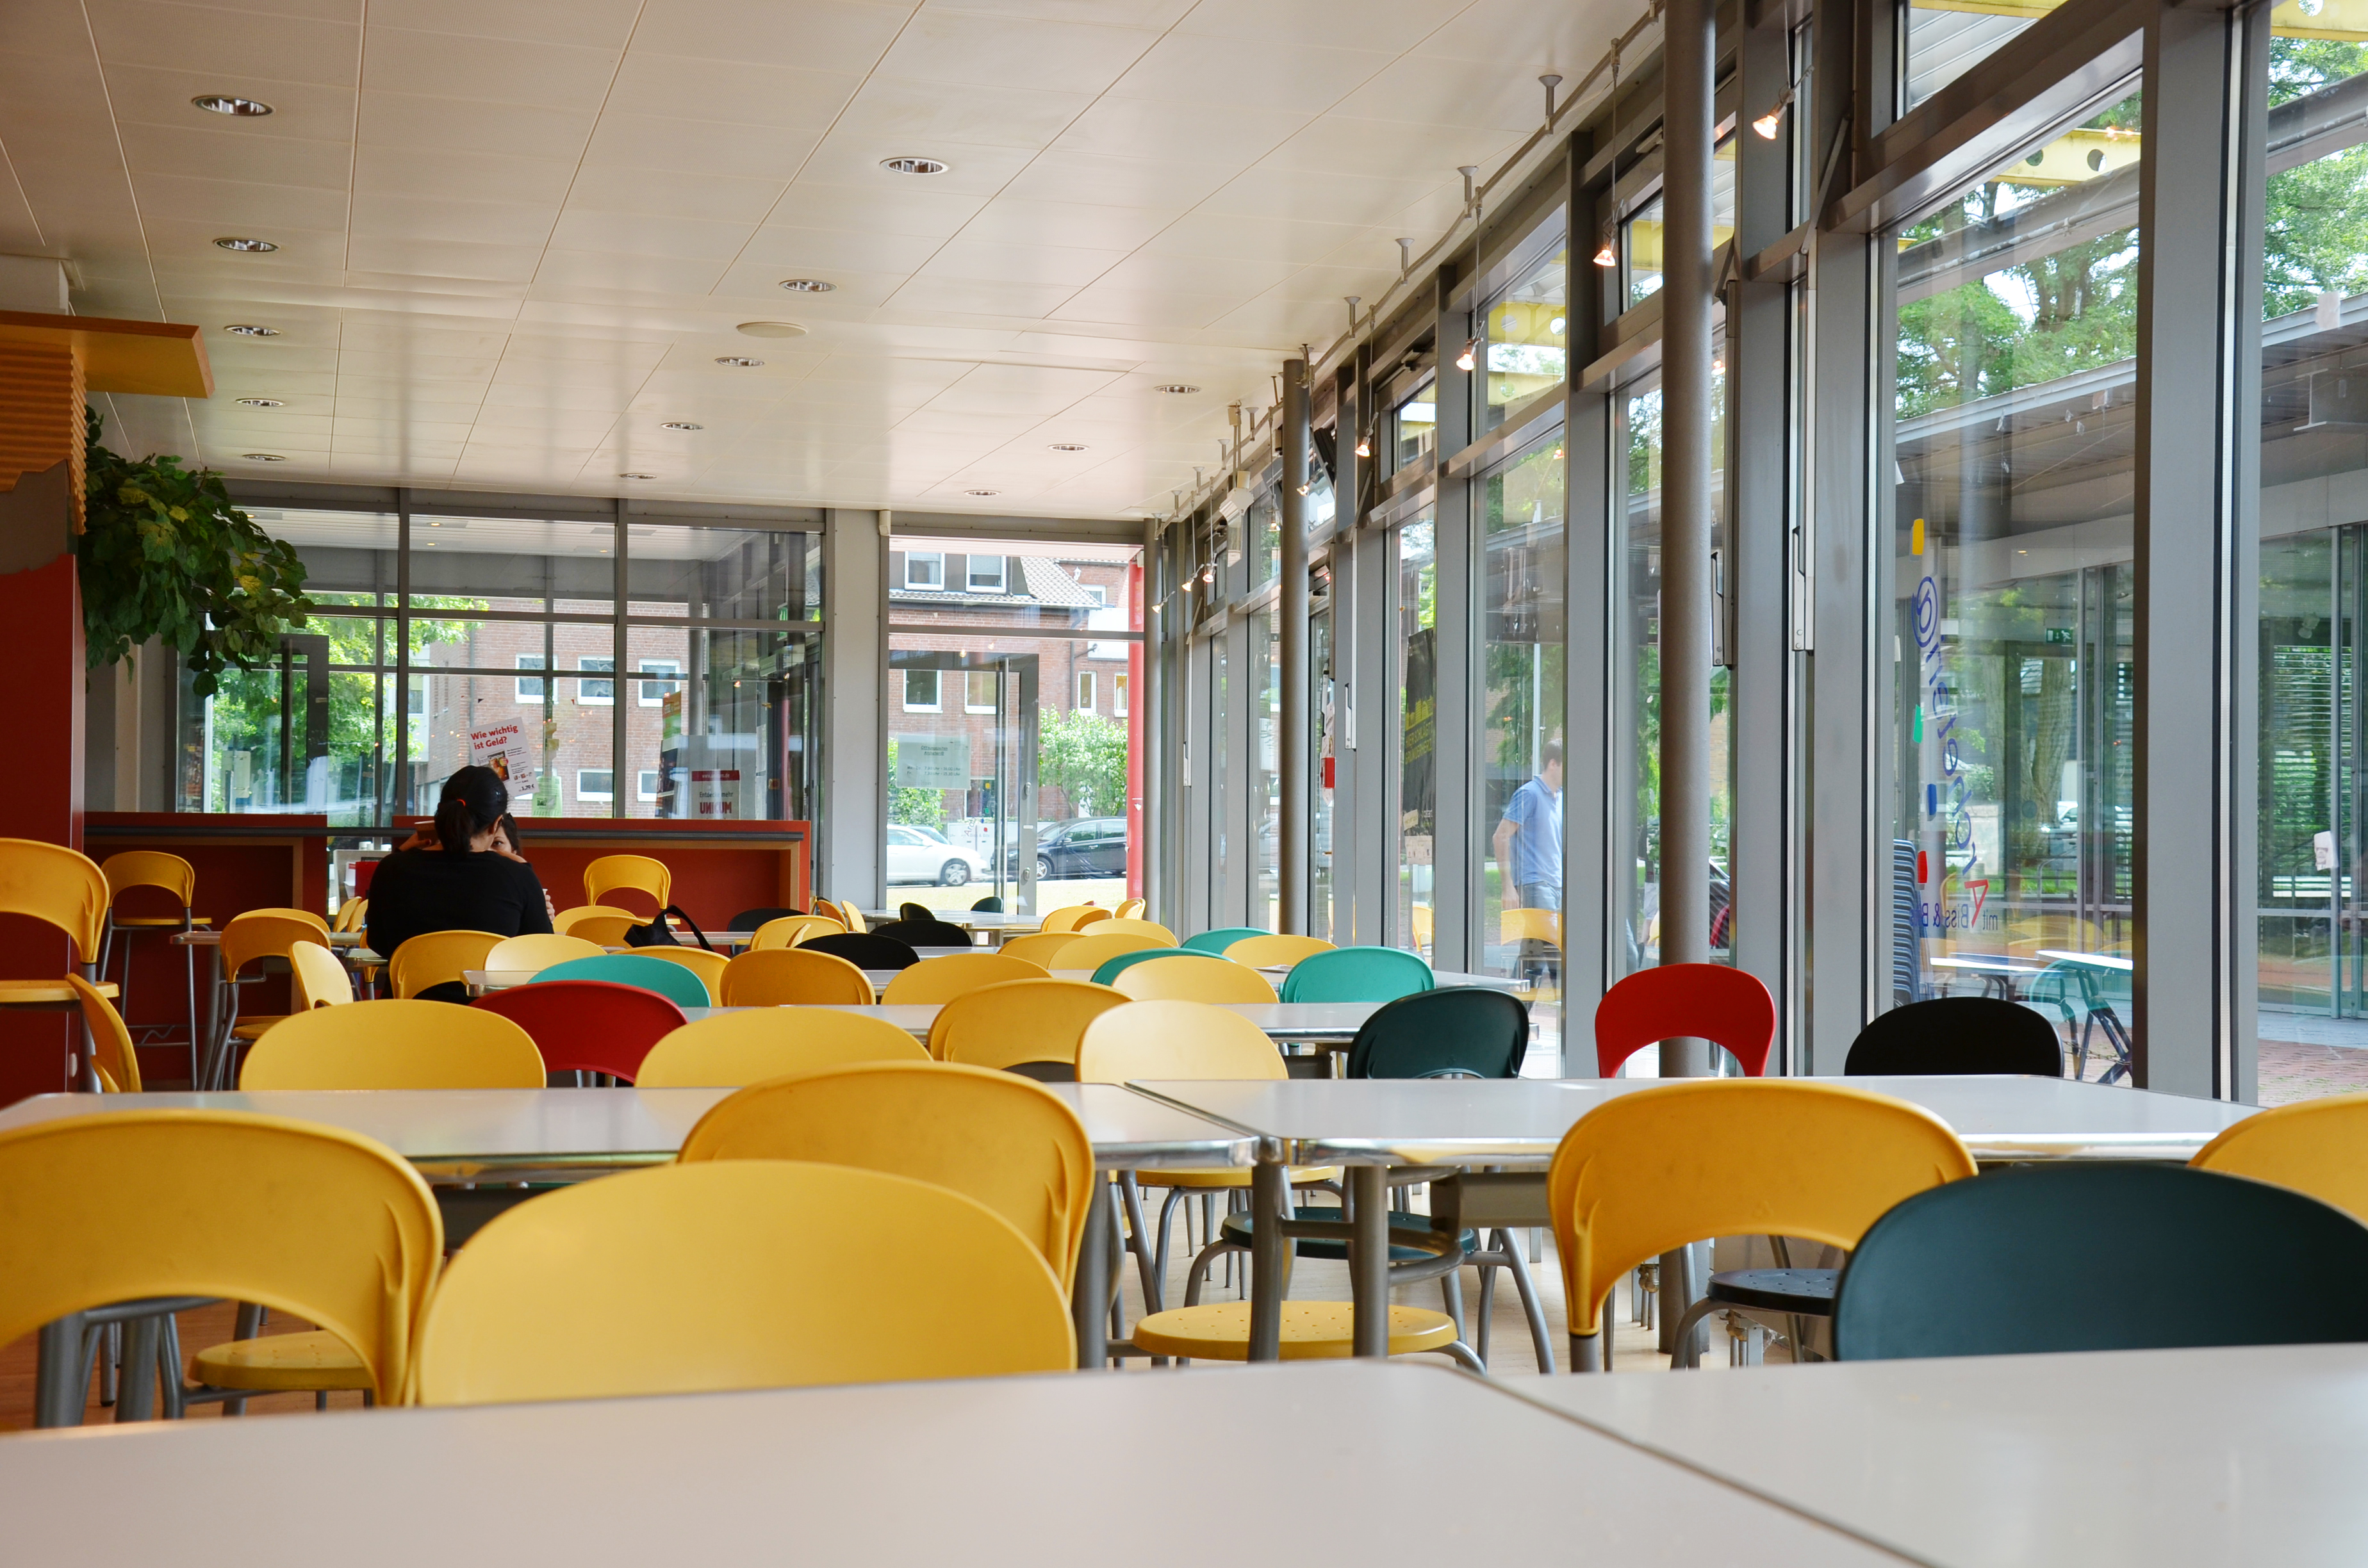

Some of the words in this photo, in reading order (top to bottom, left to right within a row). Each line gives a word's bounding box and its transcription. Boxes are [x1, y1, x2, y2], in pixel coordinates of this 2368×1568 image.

[470, 731, 487, 740] Wie
[488, 724, 518, 733] wichtig
[486, 736, 507, 747] Geld?
[700, 801, 732, 814] UNICUM
